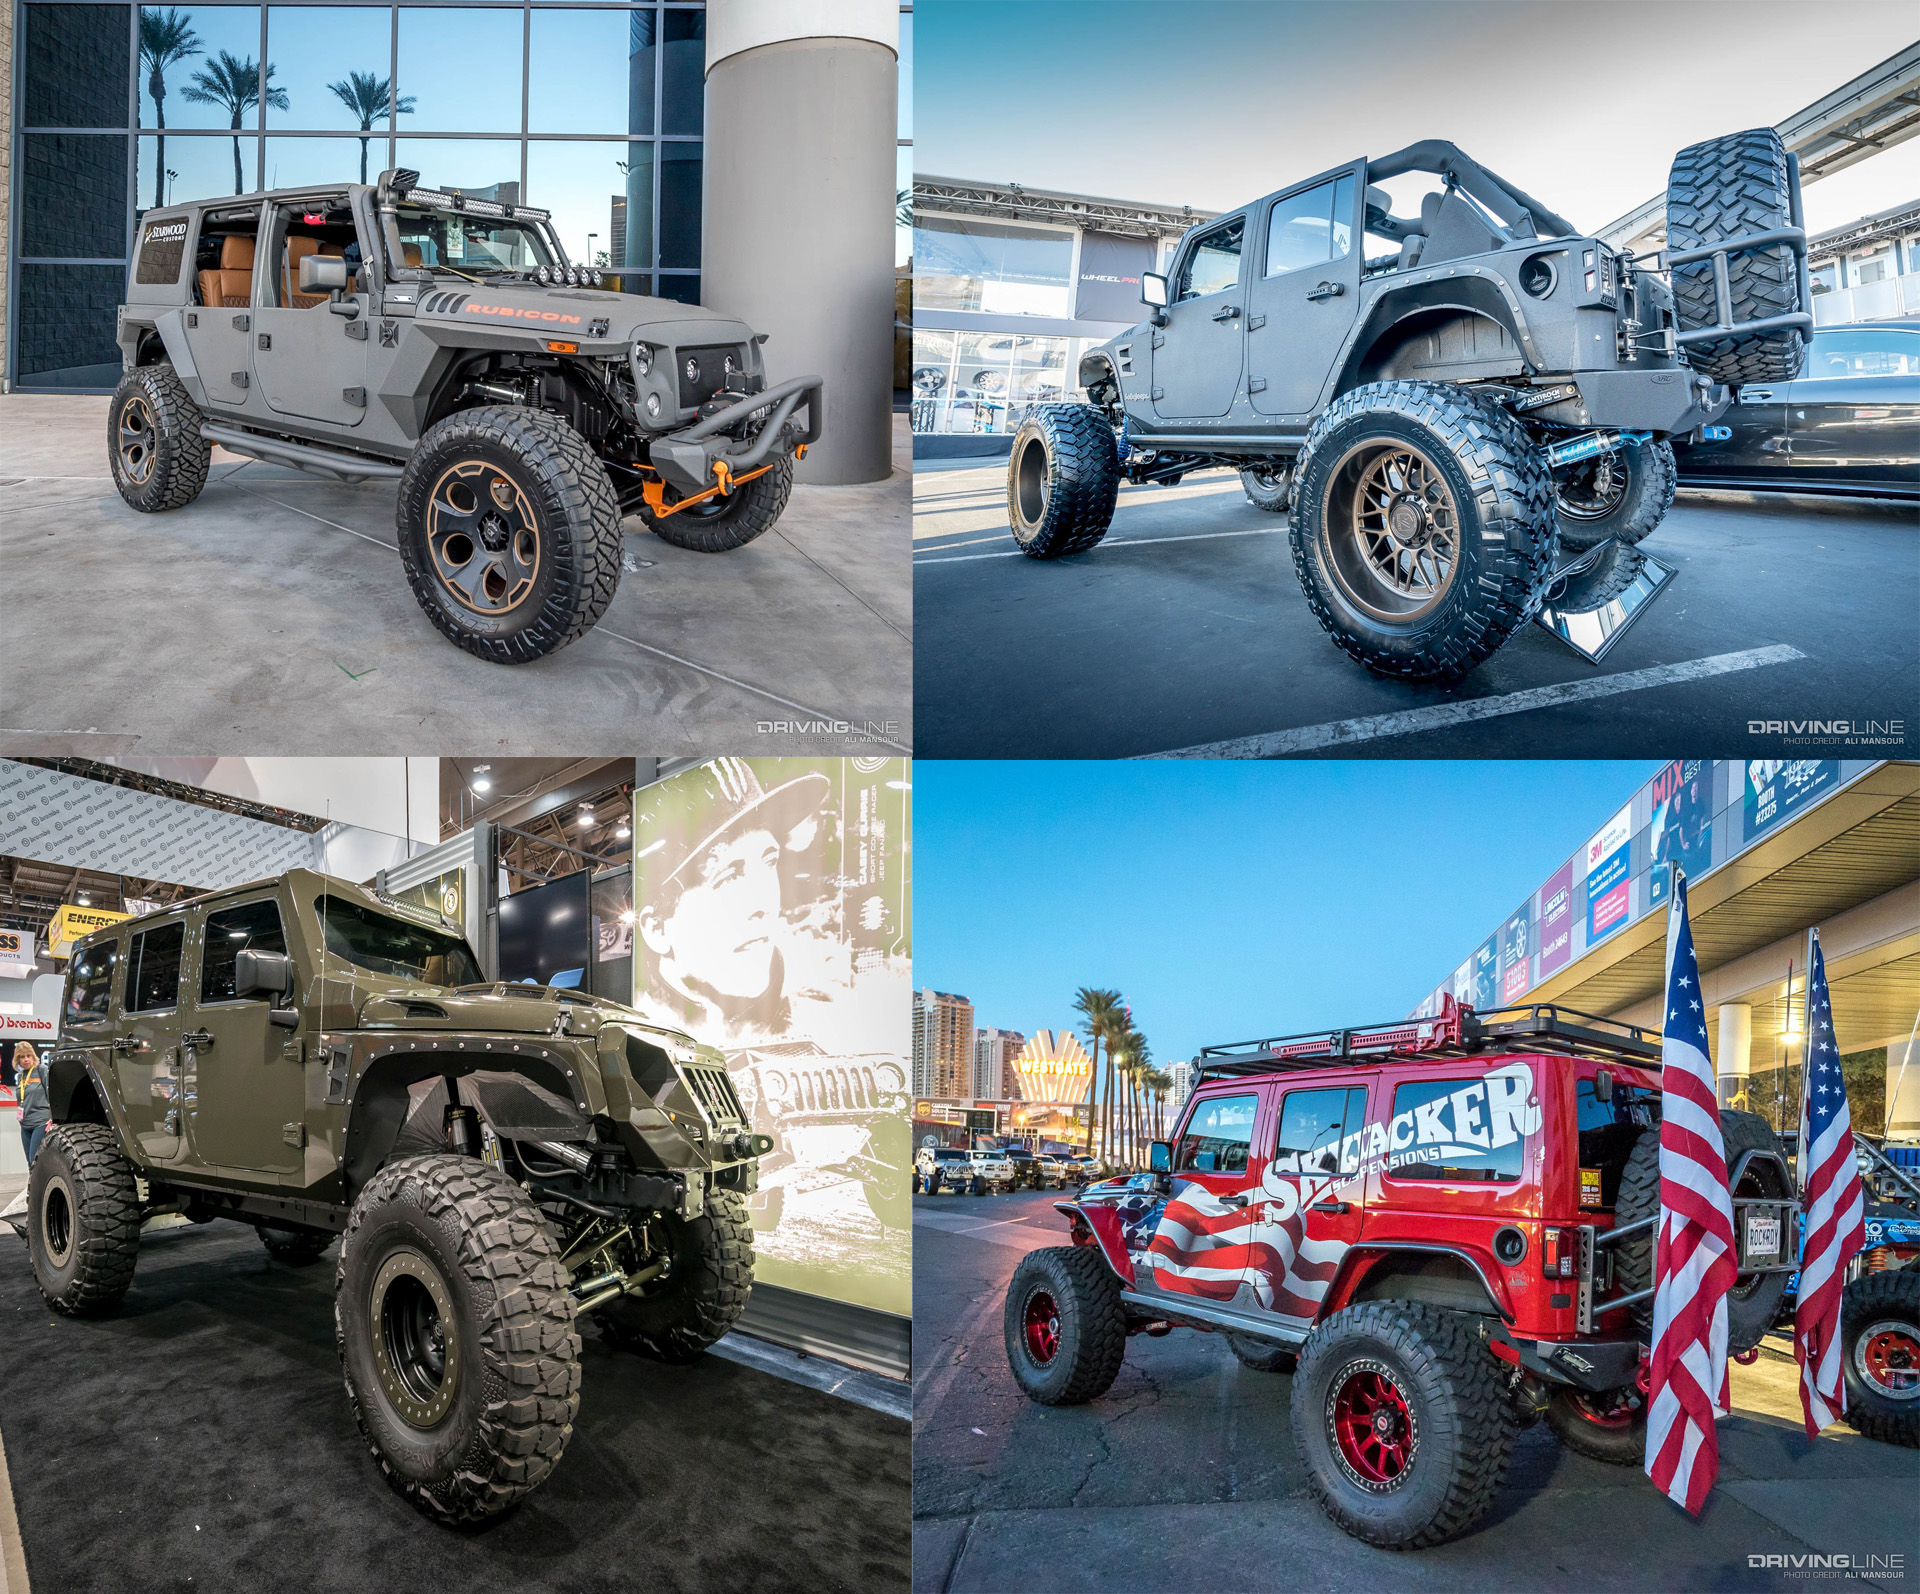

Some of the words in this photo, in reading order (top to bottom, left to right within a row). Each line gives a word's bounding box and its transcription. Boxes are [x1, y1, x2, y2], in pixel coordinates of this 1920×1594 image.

[152, 223, 187, 238] STARWOOD
[1081, 273, 1120, 283] WHEEL
[465, 303, 581, 324] RUBICON
[1527, 389, 1560, 404] ANTIROCK
[1684, 761, 1702, 784] BEST
[1, 778, 23, 791] brembo
[25, 783, 46, 796] brembo
[1652, 760, 1685, 811] MIX
[48, 788, 69, 802] brembo
[71, 794, 91, 806] brembo
[1757, 785, 1775, 809] BOOTH
[15, 804, 37, 817] brembo
[93, 798, 113, 811] brembo
[39, 809, 60, 822] brembo
[860, 788, 869, 837] CURRIE
[1755, 800, 1777, 827] #23275
[62, 814, 83, 827] brembo
[84, 818, 104, 831] brembo
[5, 825, 27, 838] brembo
[29, 829, 51, 843] brembo
[52, 834, 74, 847] brembo
[75, 838, 95, 851] brembo
[97, 842, 117, 855] brembo
[1590, 839, 1603, 864] 3M
[859, 840, 868, 886] CASEY
[1612, 858, 1620, 869] 3M
[1544, 890, 1566, 916] LINCOLN
[1548, 902, 1567, 923] ELECTRIC
[67, 913, 119, 927] ENERG
[1543, 941, 1555, 959] Booth
[1506, 961, 1526, 990] 51003
[6, 1017, 52, 1030] brembo
[1019, 1060, 1087, 1076] WESTGATE
[1262, 1062, 1543, 1223] SKYJACKER
[1331, 1145, 1442, 1194] SUSPENSIONS
